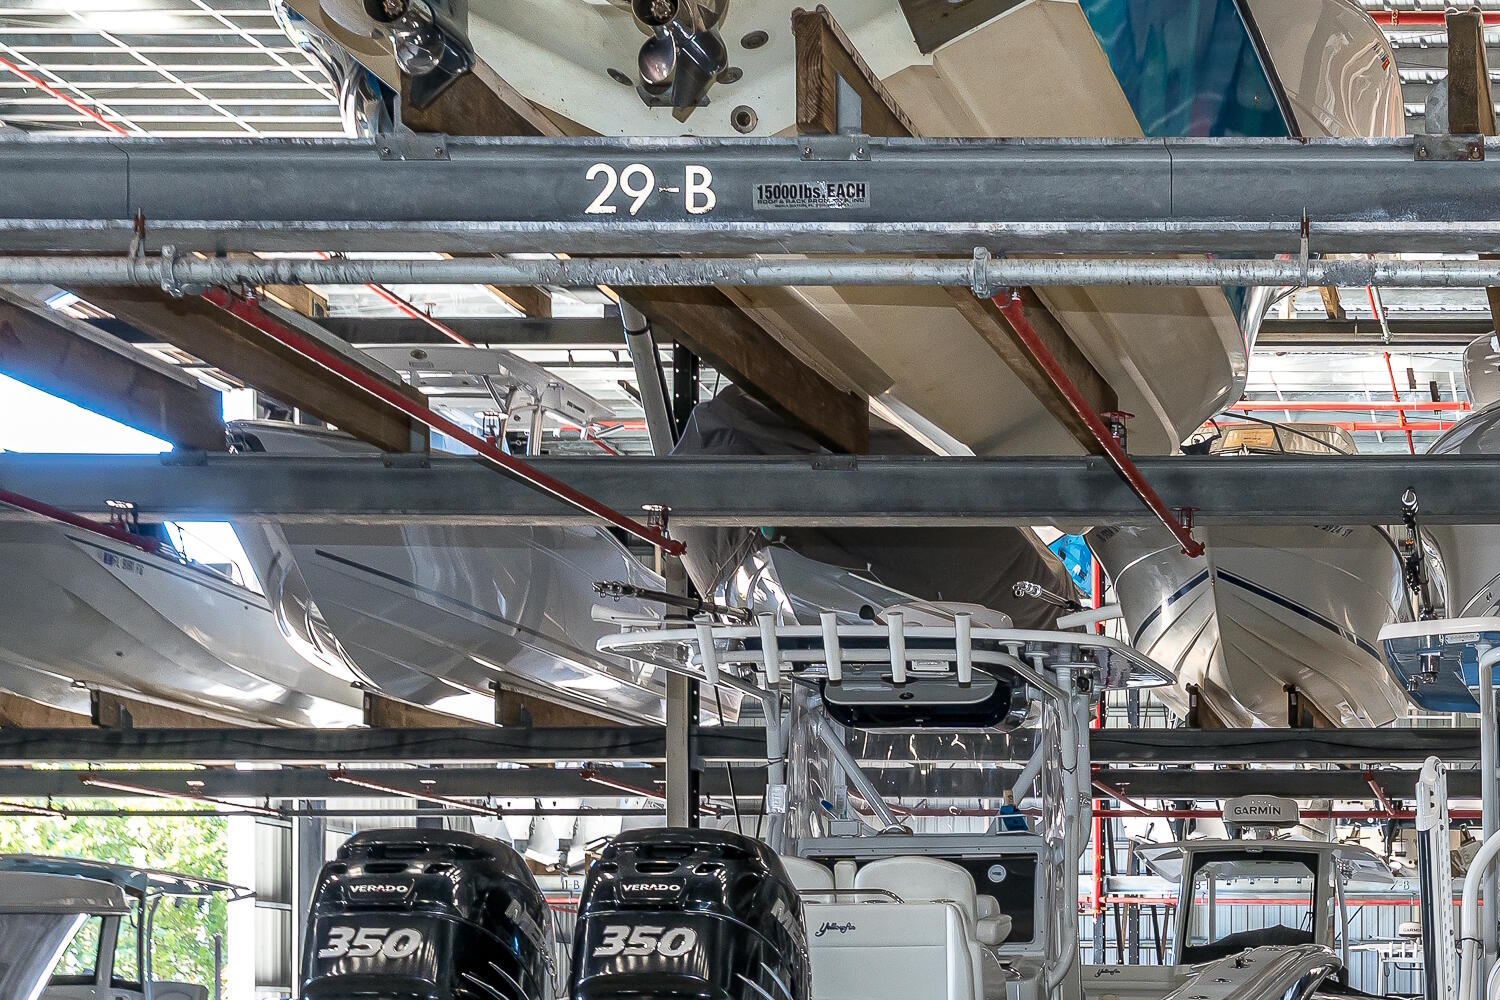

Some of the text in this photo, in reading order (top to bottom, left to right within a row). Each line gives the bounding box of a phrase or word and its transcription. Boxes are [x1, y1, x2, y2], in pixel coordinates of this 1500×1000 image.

[584, 162, 717, 216] 29-B
[1233, 806, 1281, 816] GARMIN
[350, 884, 408, 894] VERADO
[622, 883, 681, 892] VERADO
[318, 926, 423, 959] 350
[592, 925, 698, 958] 350
